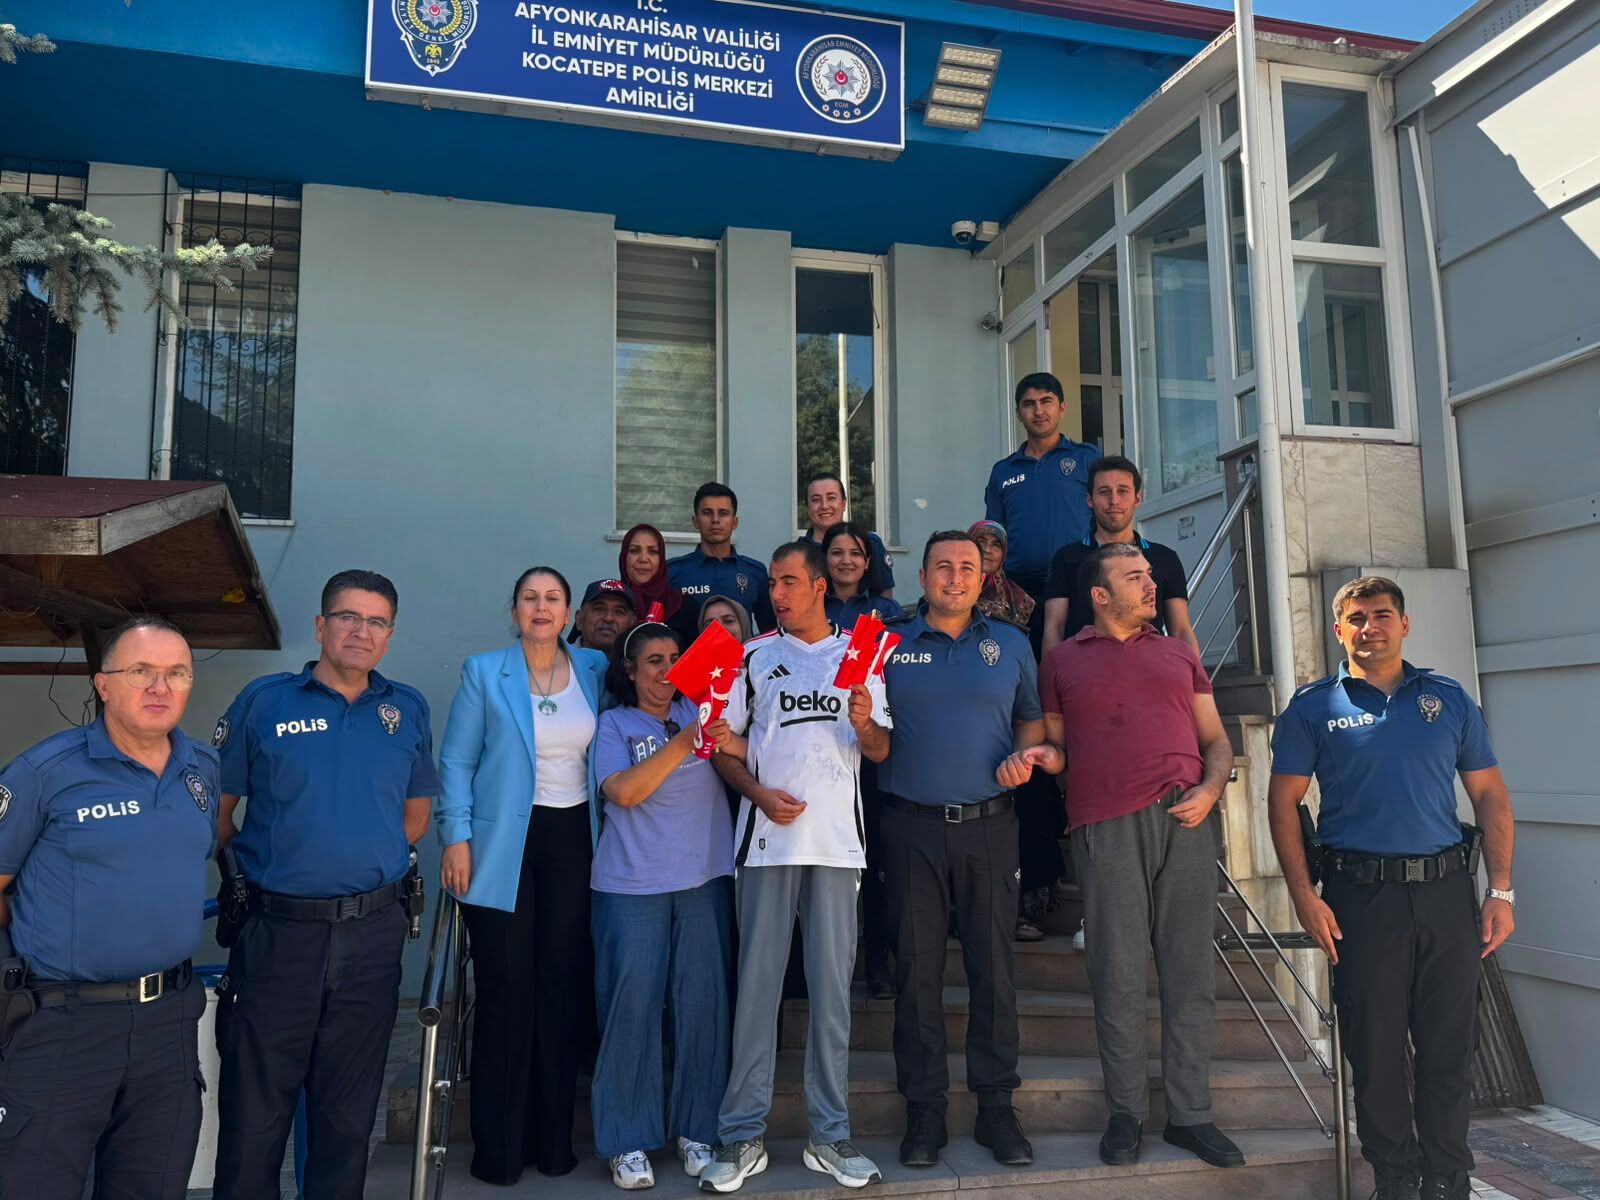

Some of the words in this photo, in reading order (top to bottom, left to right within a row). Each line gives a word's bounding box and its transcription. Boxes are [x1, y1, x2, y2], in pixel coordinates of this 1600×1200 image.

[418, 32, 449, 41] GENEL
[514, 1, 698, 41] AFYONKARAHİSAR
[702, 27, 781, 52] VALİLİĞİ
[531, 24, 548, 46] İL
[553, 31, 639, 57] EMNİYET
[643, 41, 765, 74] MÜDÜRLÜĞÜ
[522, 51, 628, 81] KOCATEPE
[632, 65, 689, 88] POLİS
[694, 72, 773, 99] MERKEZİ
[605, 86, 695, 112] AMİRLİĞİ
[779, 690, 842, 714] beko
